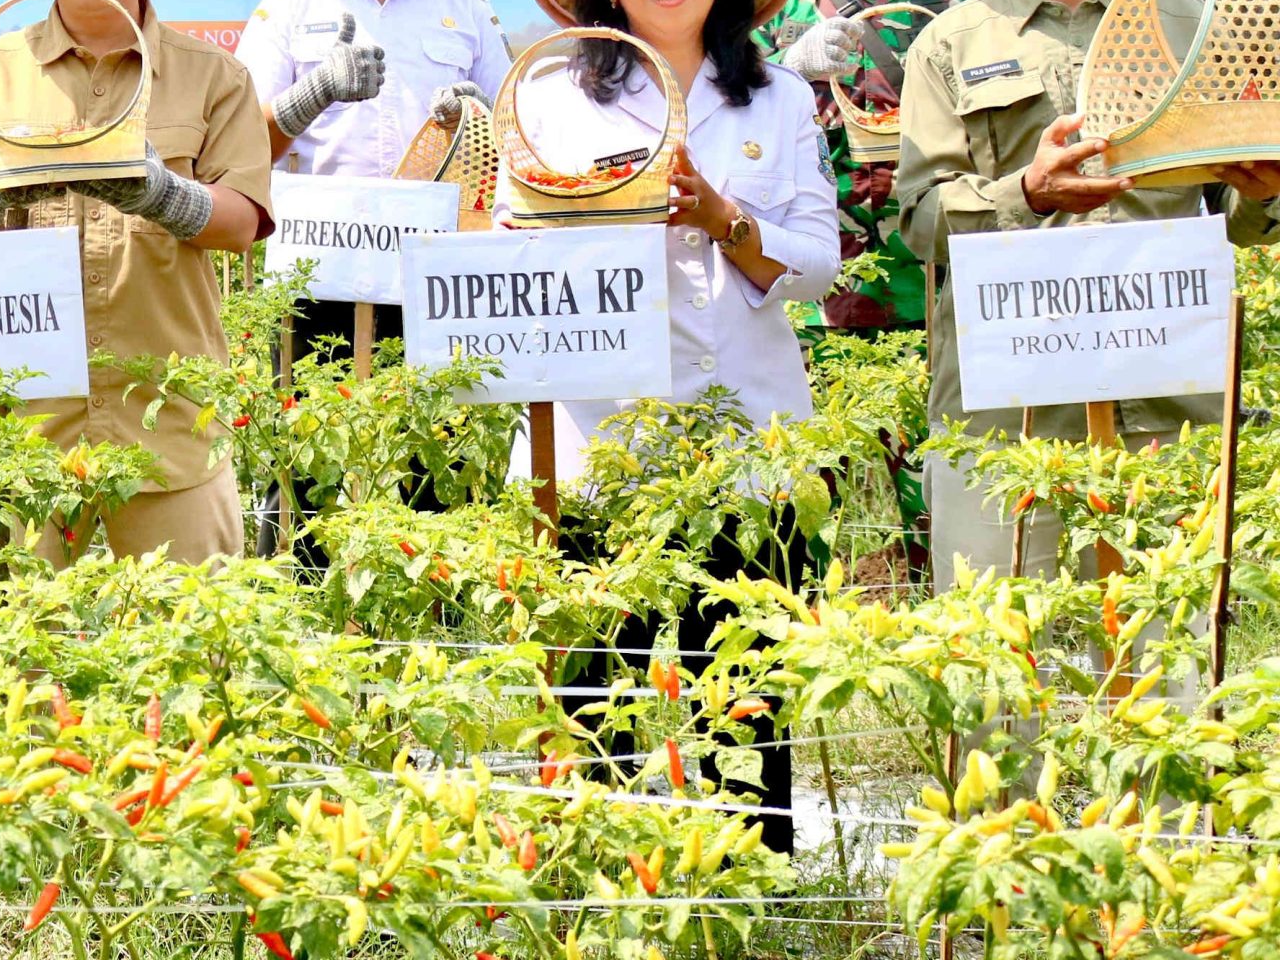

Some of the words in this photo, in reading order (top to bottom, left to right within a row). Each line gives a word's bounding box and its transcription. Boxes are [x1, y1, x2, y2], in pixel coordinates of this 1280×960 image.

[425, 270, 580, 320] DIPERTA
[595, 267, 644, 314] KP
[977, 281, 1024, 321] UPT
[1030, 272, 1155, 318] PROTEKSI
[1159, 268, 1209, 308] TPH
[448, 331, 531, 357] PROV.
[540, 328, 628, 354] JATIM
[1012, 332, 1085, 356] PROV.
[1093, 326, 1167, 351] JATIM
